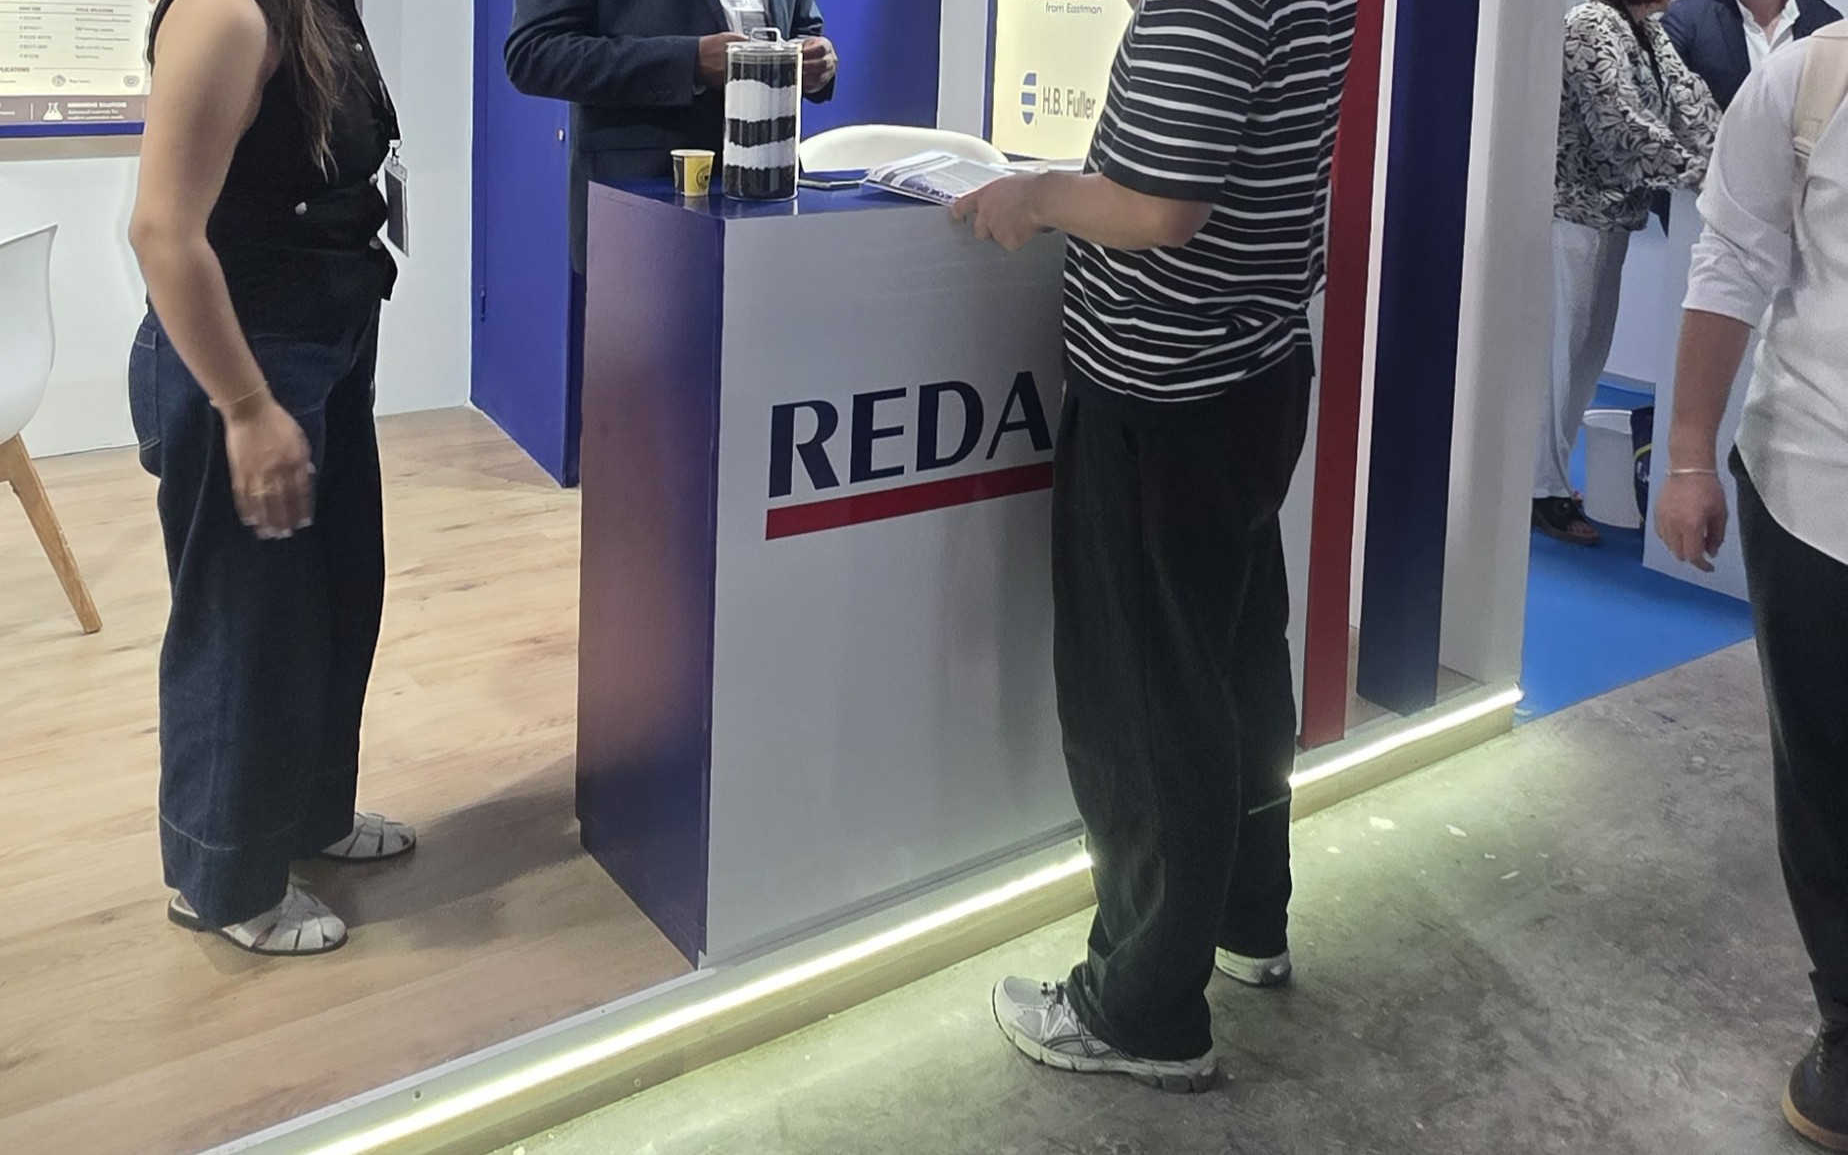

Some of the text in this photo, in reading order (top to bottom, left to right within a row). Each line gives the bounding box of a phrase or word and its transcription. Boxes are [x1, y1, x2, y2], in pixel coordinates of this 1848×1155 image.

[1045, 3, 1103, 15] from Eastman
[1042, 87, 1096, 121] H.B. Fuller
[768, 371, 1053, 499] REDA
